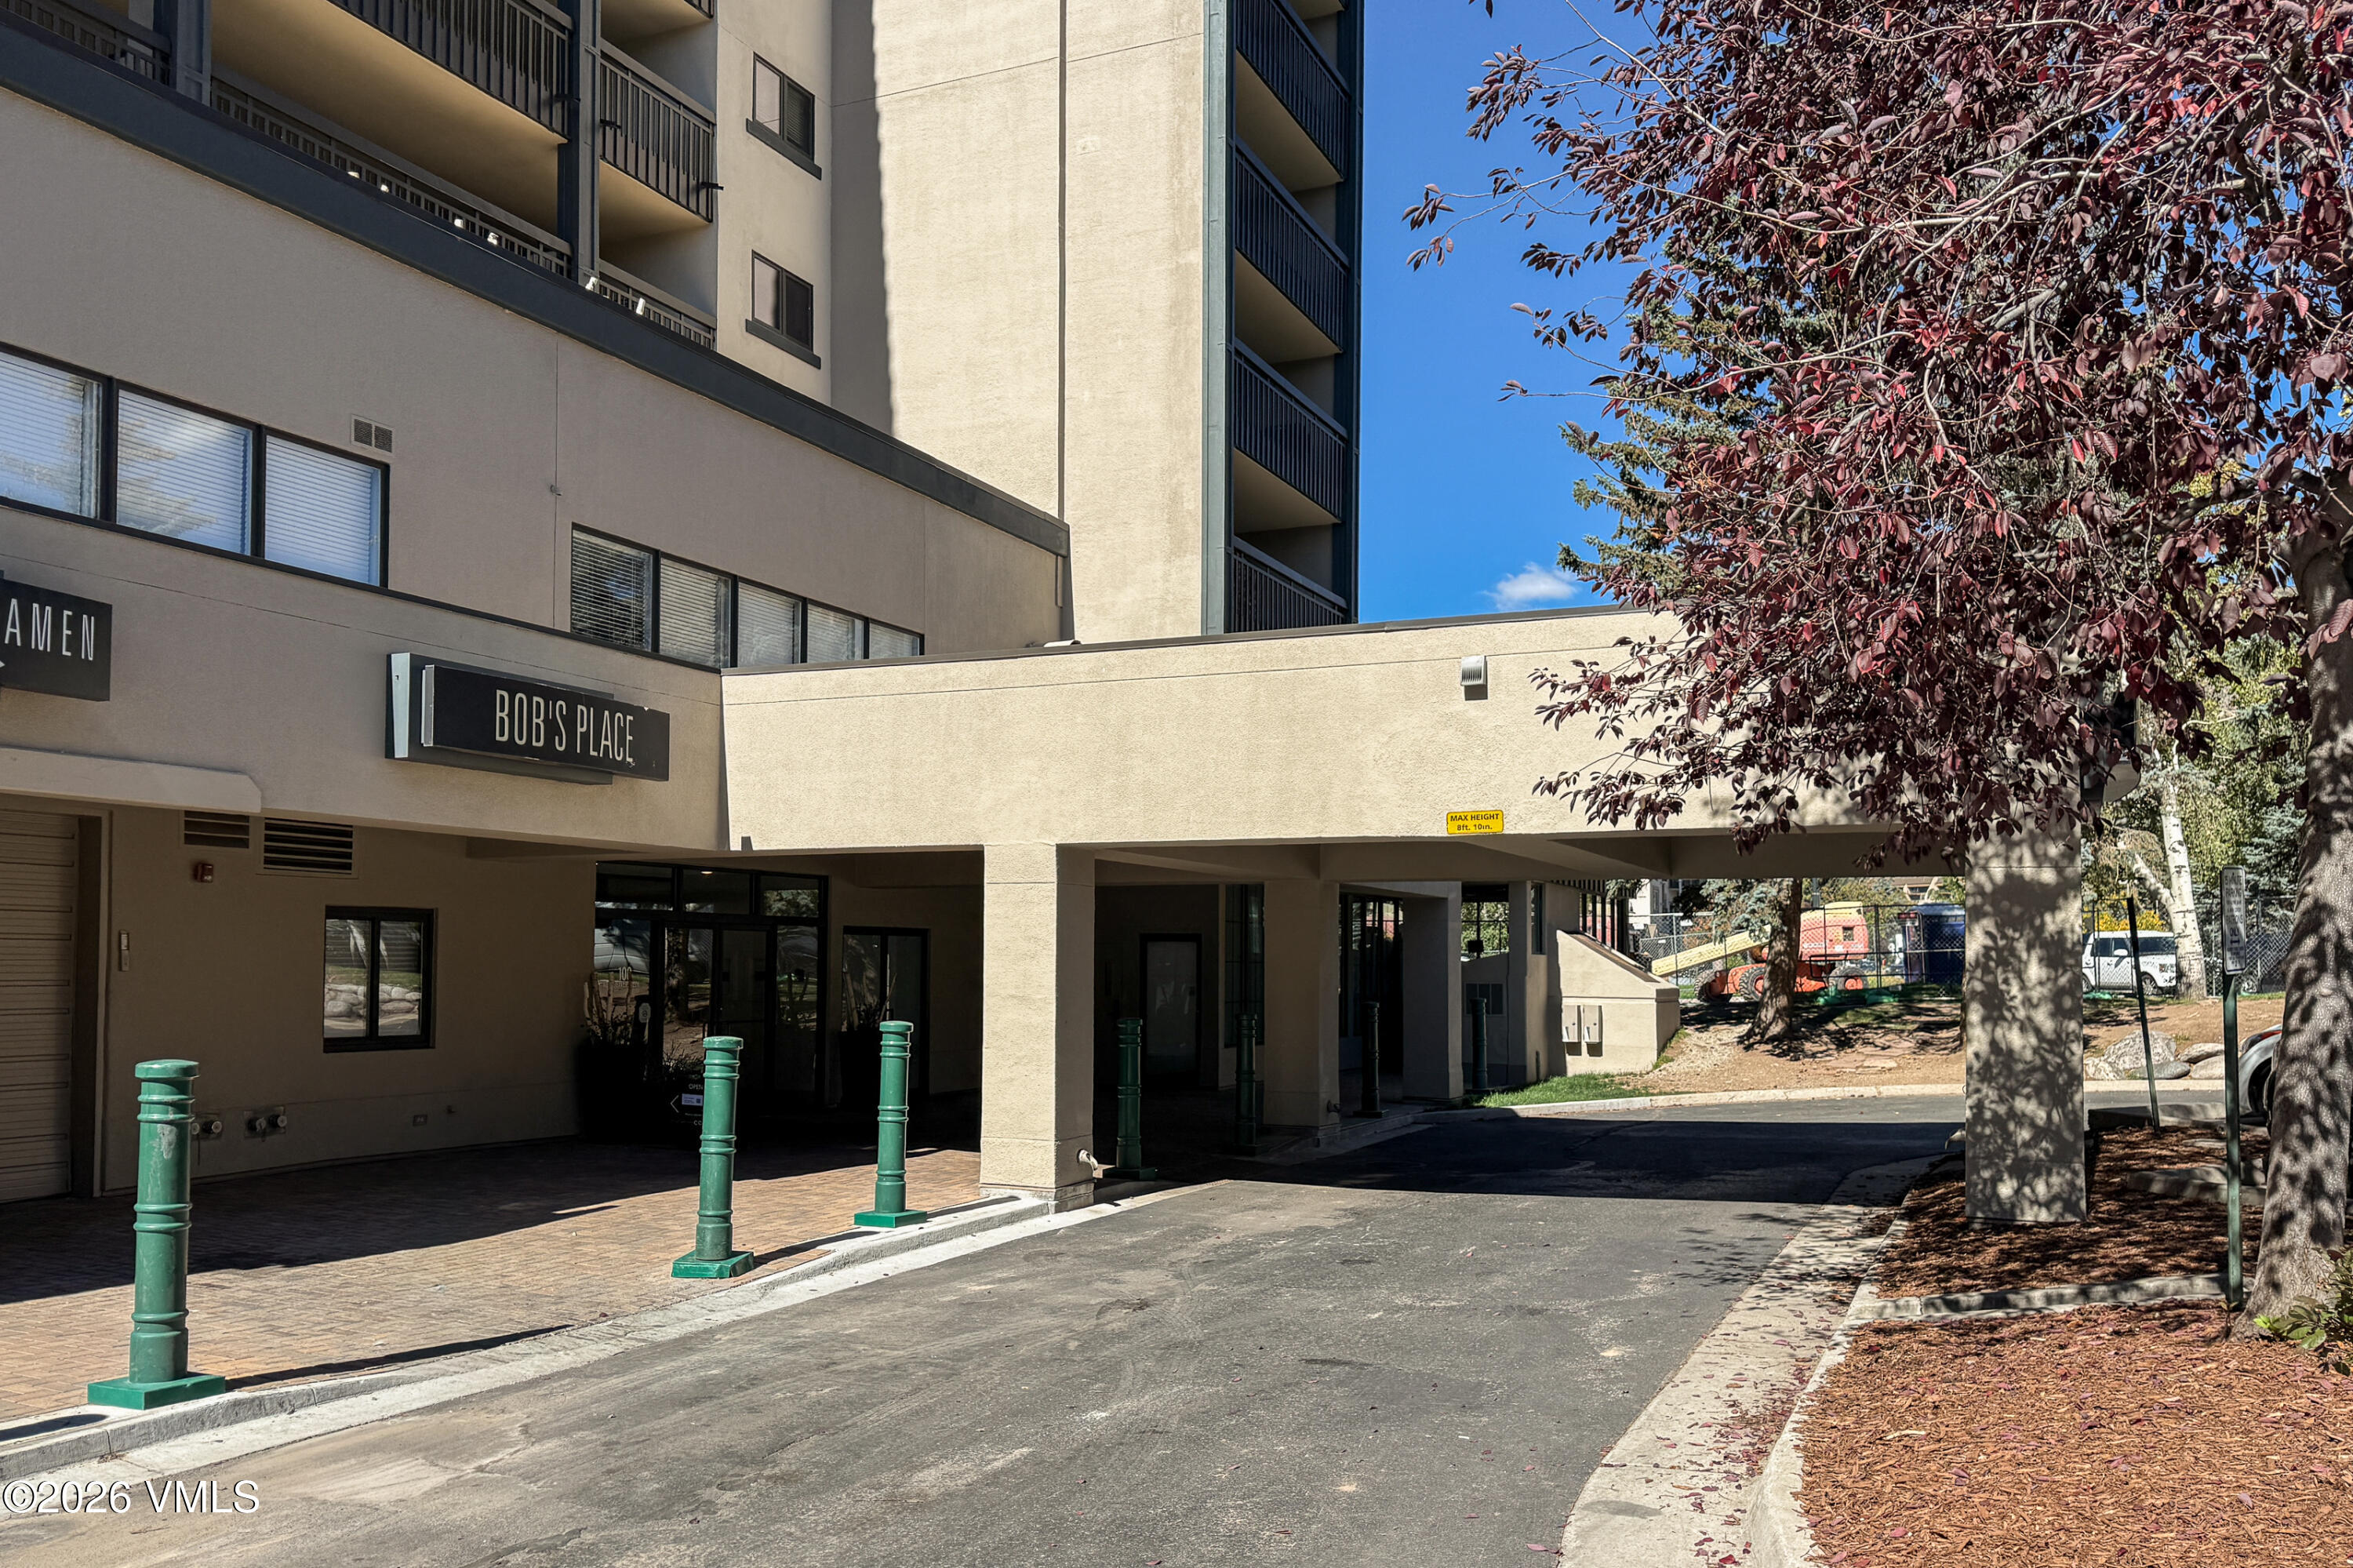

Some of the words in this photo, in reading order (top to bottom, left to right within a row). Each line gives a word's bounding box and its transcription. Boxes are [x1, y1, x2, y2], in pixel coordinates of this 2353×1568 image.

[4, 598, 95, 660] AMEN
[496, 689, 566, 751] BOB'S
[576, 704, 634, 762] PLACE
